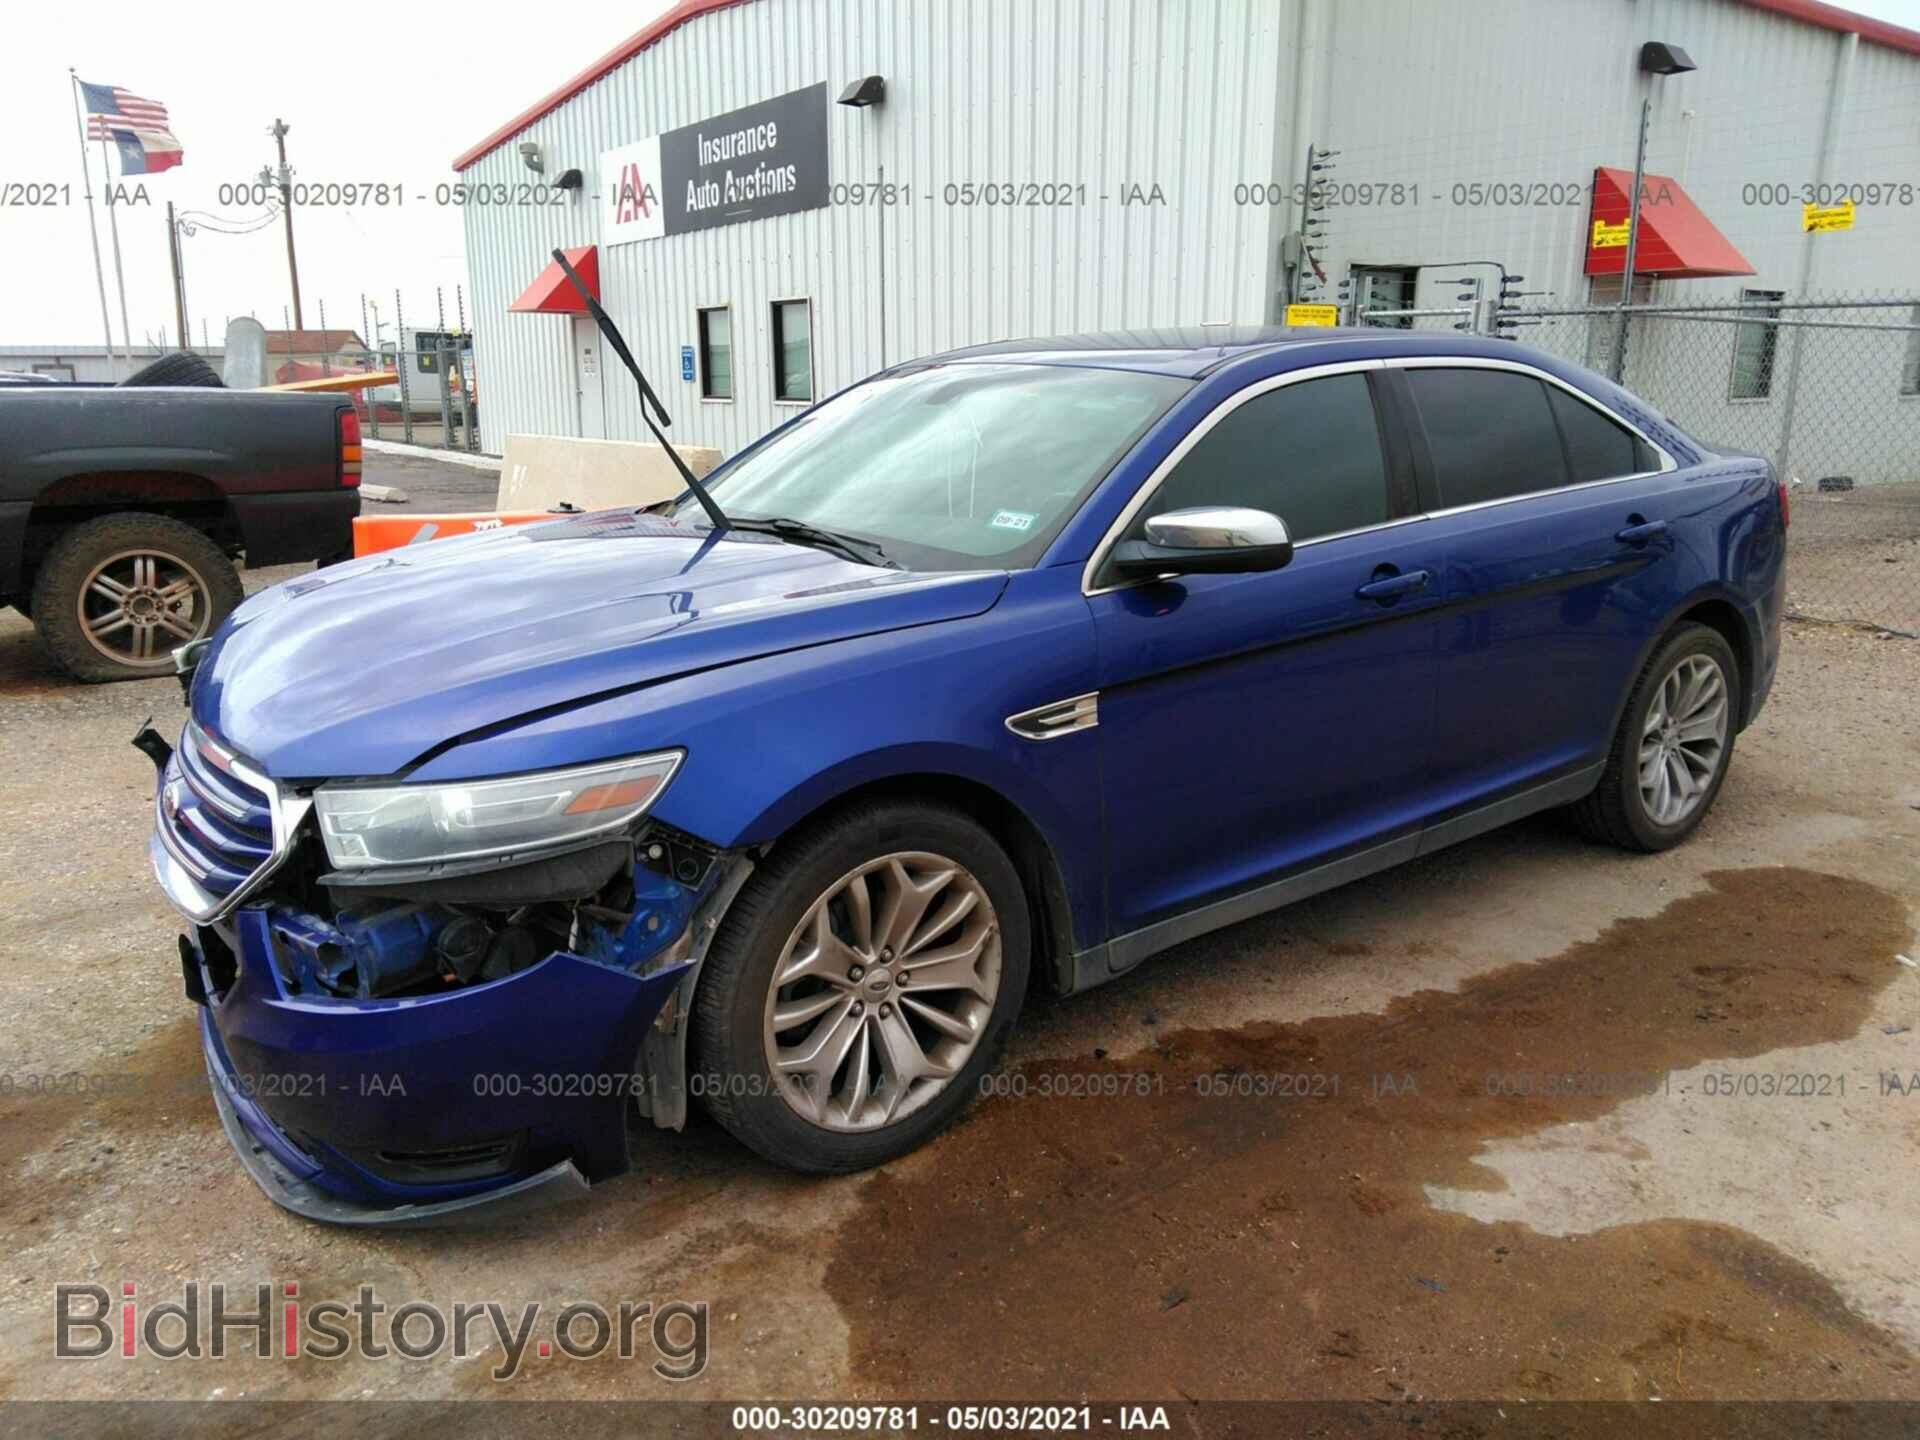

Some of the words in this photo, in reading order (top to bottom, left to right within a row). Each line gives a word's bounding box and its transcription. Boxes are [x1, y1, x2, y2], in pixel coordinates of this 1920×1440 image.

[698, 121, 777, 166] Insurance
[686, 179, 719, 212] Auto
[724, 161, 797, 204] Auctions
